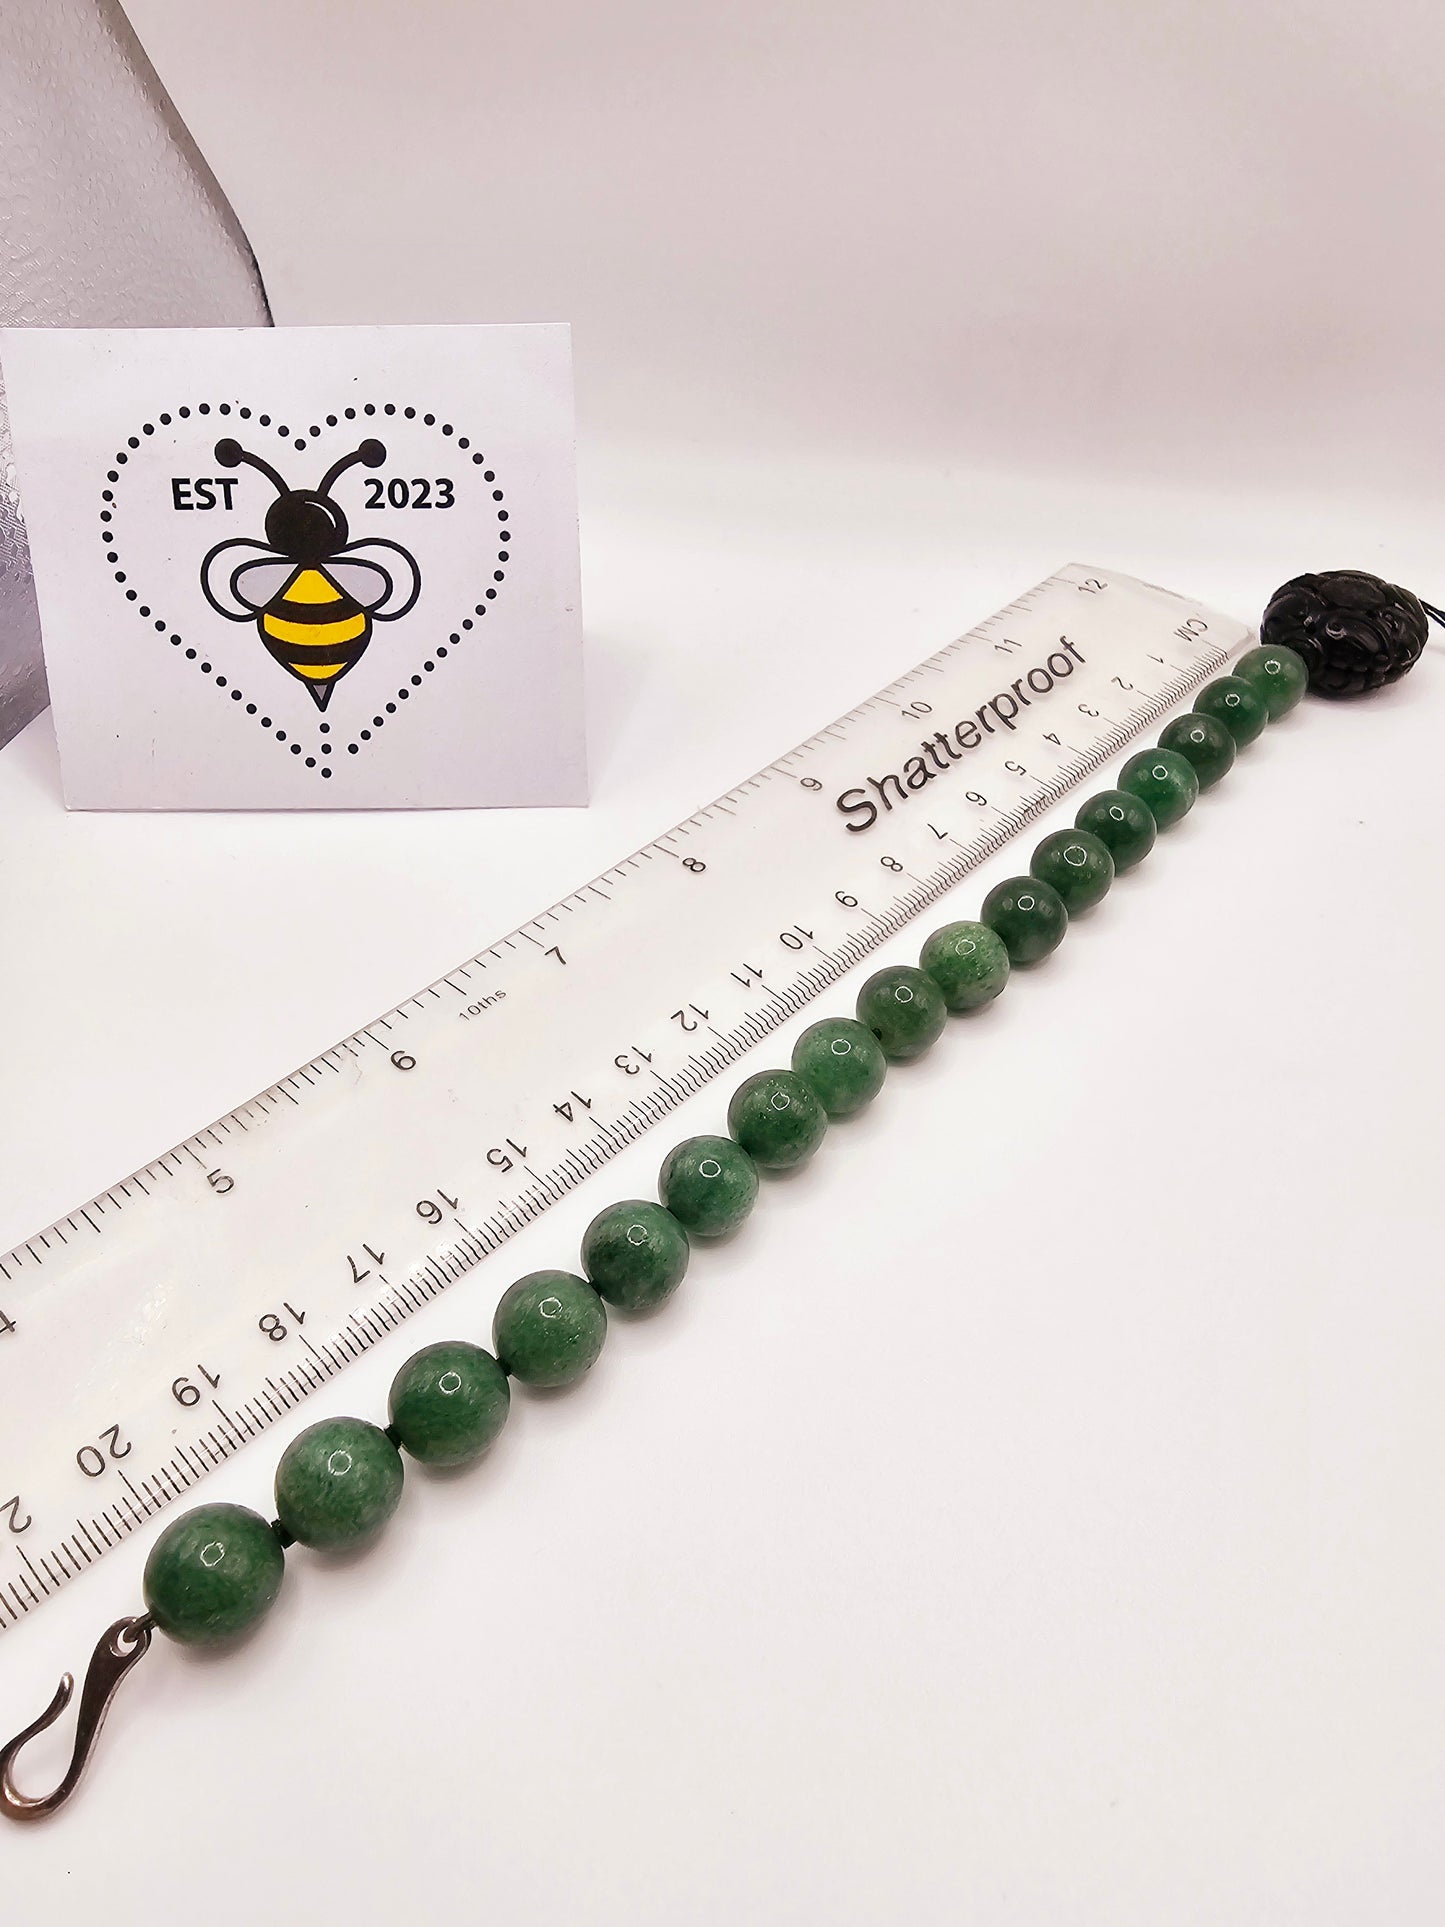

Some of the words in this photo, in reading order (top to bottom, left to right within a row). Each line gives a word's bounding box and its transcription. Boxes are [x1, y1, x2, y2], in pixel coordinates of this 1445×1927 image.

[171, 478, 238, 510] EST
[364, 478, 455, 509] 2023
[1173, 618, 1209, 642] CM
[1146, 653, 1165, 665] 1
[1111, 676, 1134, 691] 2
[1078, 703, 1100, 718] 3
[836, 635, 1086, 833] Shatterproof
[1042, 732, 1062, 747] 4
[1004, 760, 1028, 777] 5
[965, 791, 988, 807] 6
[927, 822, 948, 841] 7
[880, 856, 904, 873] 8
[207, 1168, 235, 1194] 5
[389, 1049, 417, 1072] 6
[544, 945, 567, 966] 7
[682, 857, 707, 875] 8
[799, 776, 824, 793] 9
[901, 701, 933, 721] 10
[993, 638, 1023, 655] 11
[1078, 577, 1108, 595] 12
[835, 891, 858, 909] 9
[780, 925, 814, 951] 10
[730, 963, 763, 988] 11
[458, 987, 507, 1022] 10ths
[670, 1003, 709, 1032] 12
[614, 1046, 653, 1076] 13
[553, 1091, 592, 1123] 14
[486, 1139, 528, 1173] 15
[416, 1189, 459, 1225] 16
[346, 1244, 385, 1284] 17
[259, 1303, 306, 1342] 18
[172, 1364, 221, 1408] 19
[76, 1424, 133, 1478] 20
